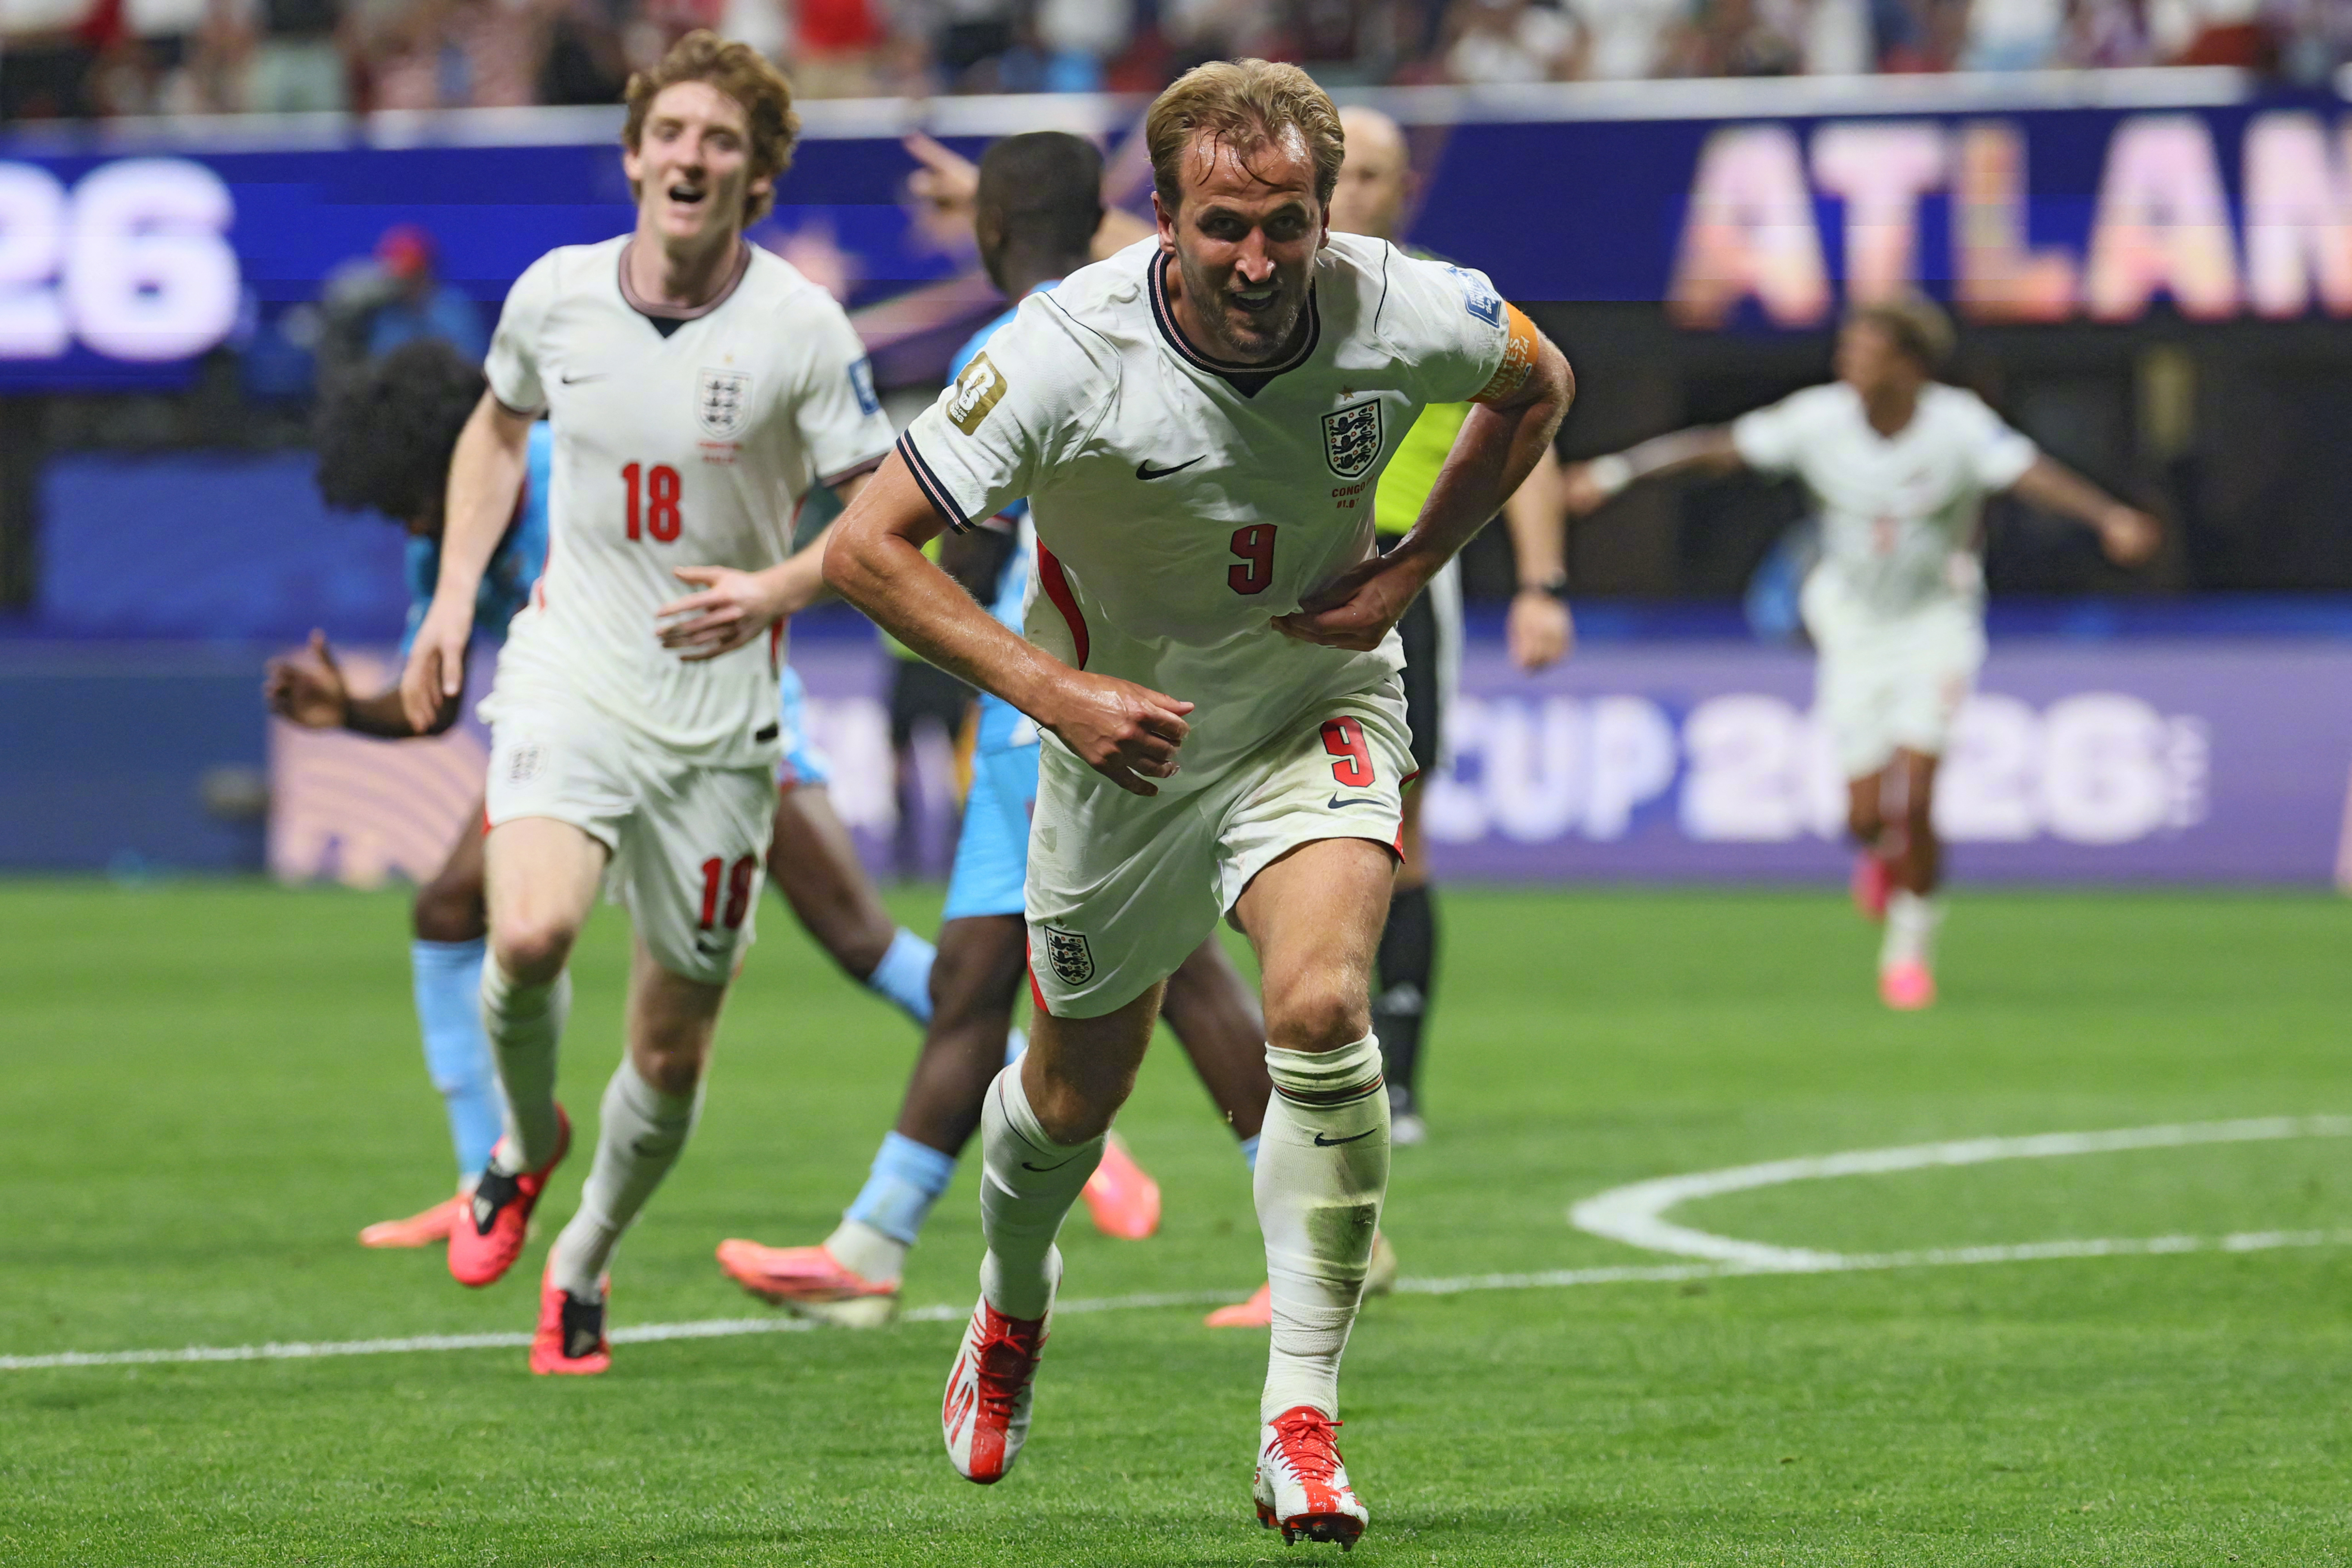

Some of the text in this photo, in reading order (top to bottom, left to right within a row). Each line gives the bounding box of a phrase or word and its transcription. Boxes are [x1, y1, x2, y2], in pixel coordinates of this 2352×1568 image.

[1482, 338, 1520, 396] UNITES
[949, 402, 964, 423] 026
[621, 462, 681, 543] 18
[1332, 481, 1365, 497] CONGO
[1227, 523, 1278, 595] 9
[1319, 715, 1376, 788] 9
[1422, 695, 1676, 842] CUP
[700, 855, 753, 929] 18
